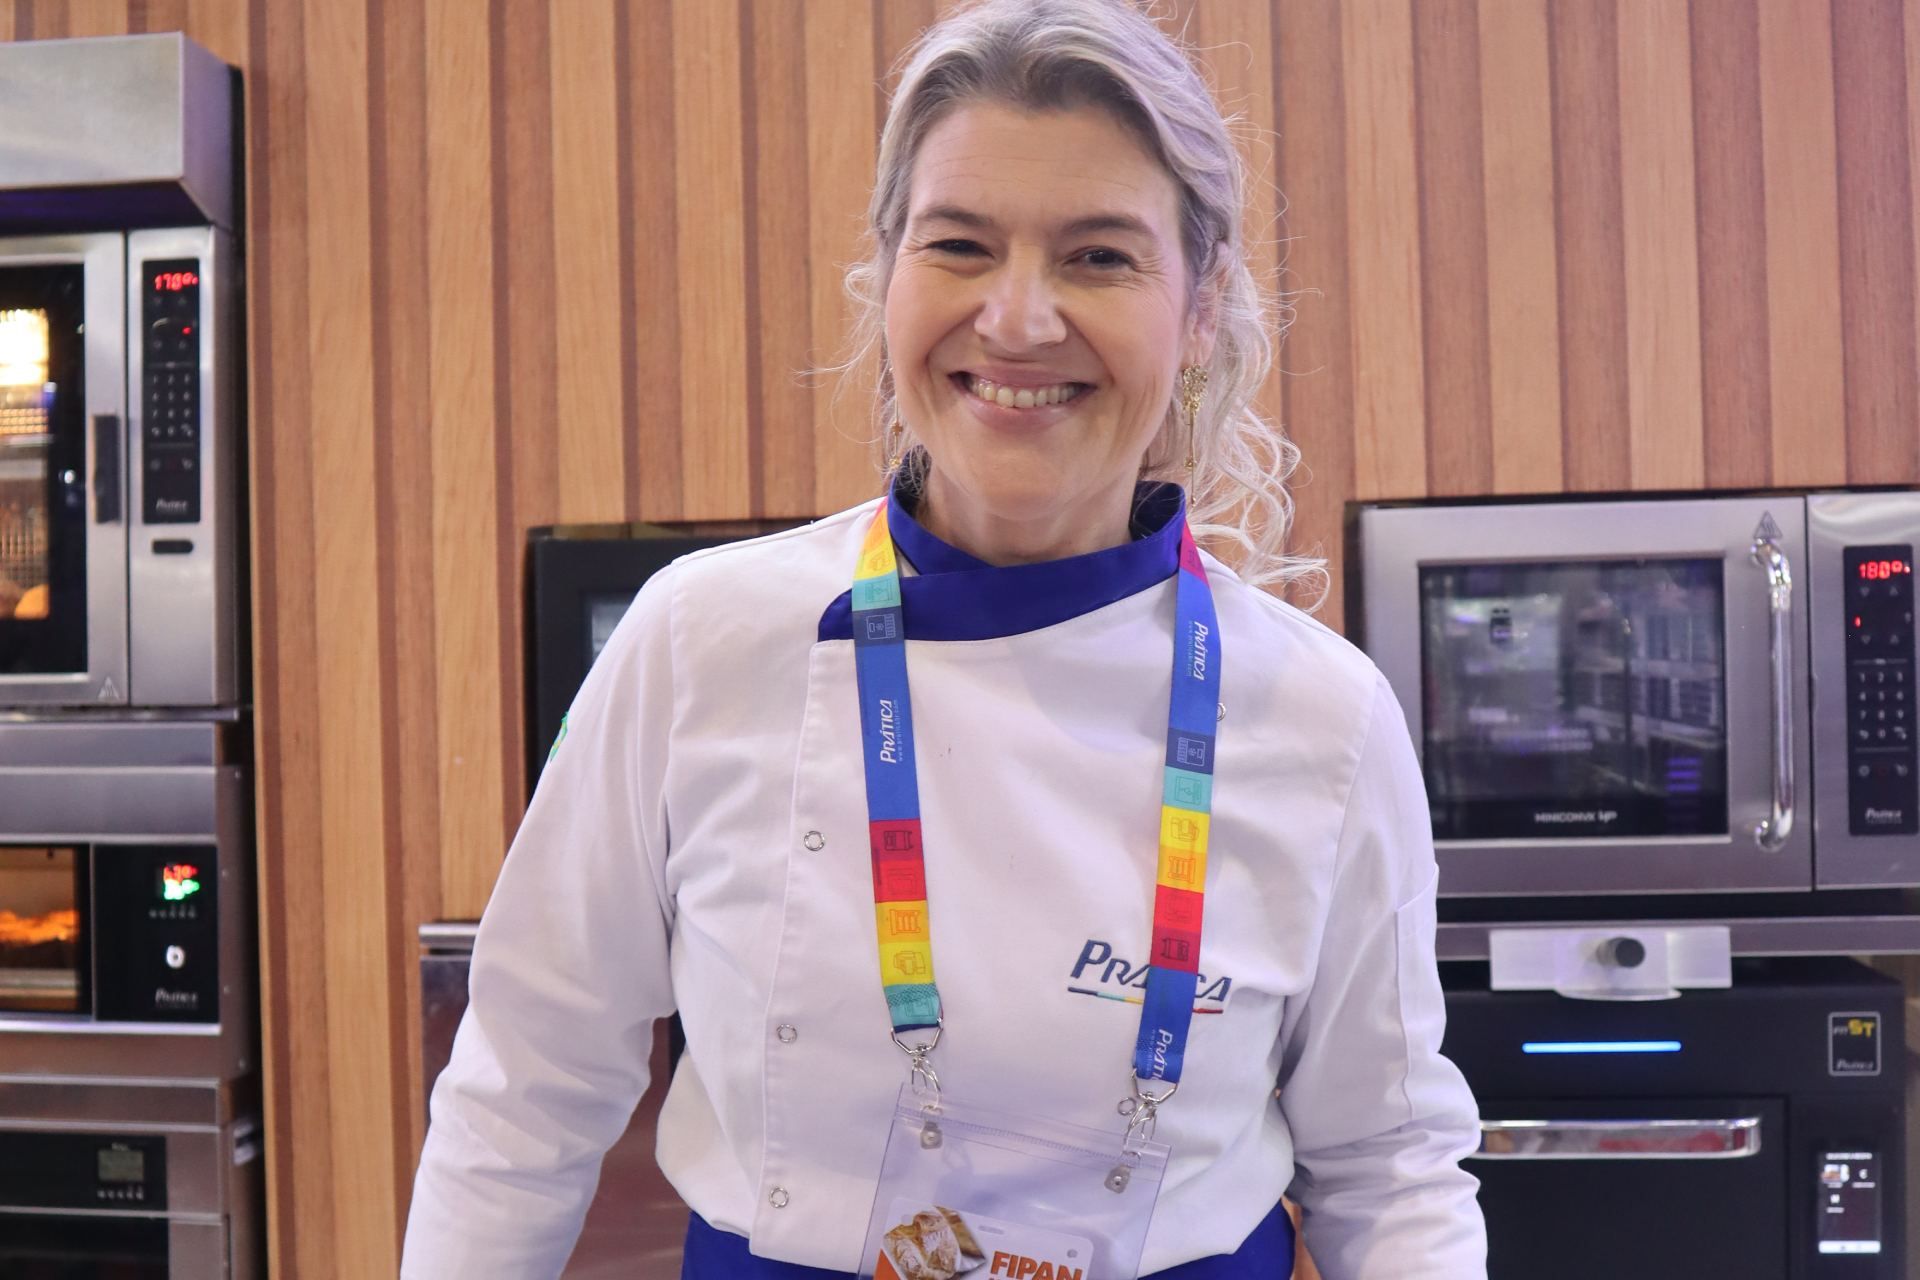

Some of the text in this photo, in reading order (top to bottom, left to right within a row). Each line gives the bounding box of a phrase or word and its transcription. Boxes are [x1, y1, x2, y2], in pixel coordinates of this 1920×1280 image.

[1193, 620, 1209, 681] PRÁTICA
[880, 699, 897, 764] PRÁTICA
[990, 1250, 1083, 1280] FIPAN
